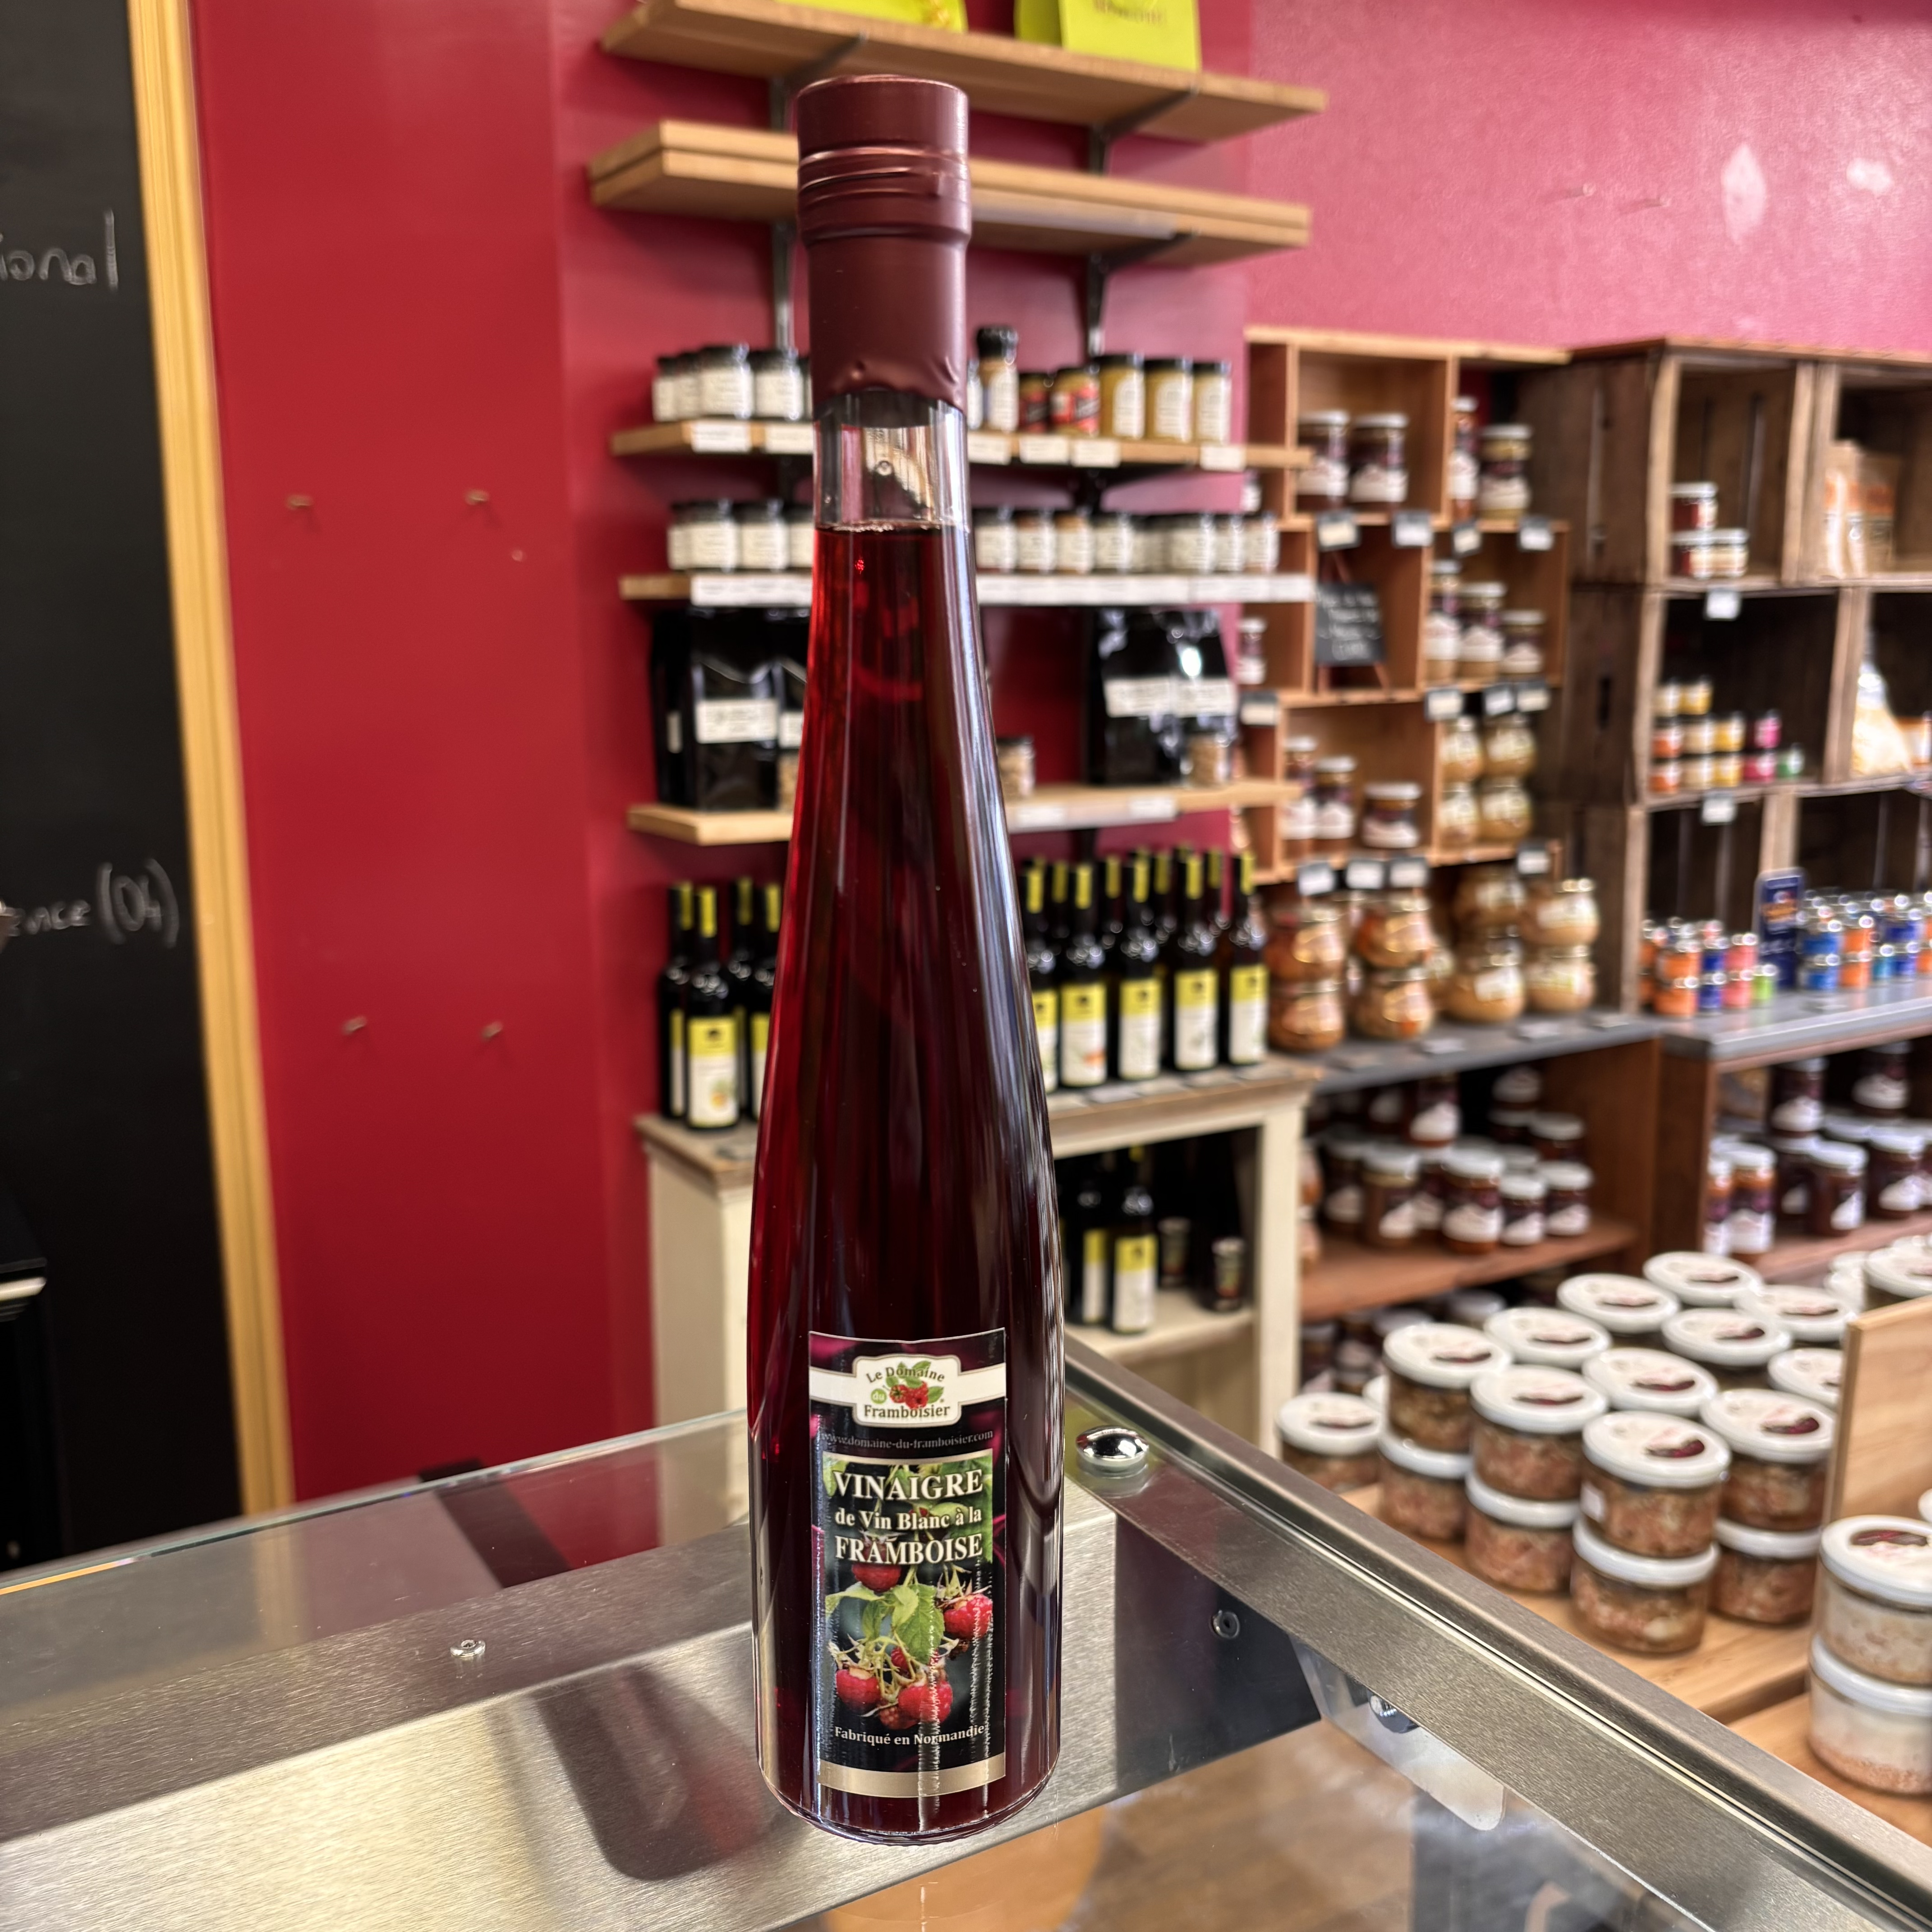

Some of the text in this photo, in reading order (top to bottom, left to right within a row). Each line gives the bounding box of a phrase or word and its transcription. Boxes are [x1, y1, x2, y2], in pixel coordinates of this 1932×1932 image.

[866, 1366, 945, 1383] Le Domaine
[872, 1390, 885, 1399] du
[864, 1404, 950, 1418] Framboisier
[820, 1430, 993, 1449] www.domaine-du-framboisier.com
[833, 1469, 983, 1501] VINAIGRE
[835, 1506, 982, 1530] de Vin Blanc à la
[835, 1533, 983, 1565] FRAMBOISE
[835, 1724, 984, 1746] Fabriqué en Normandie
